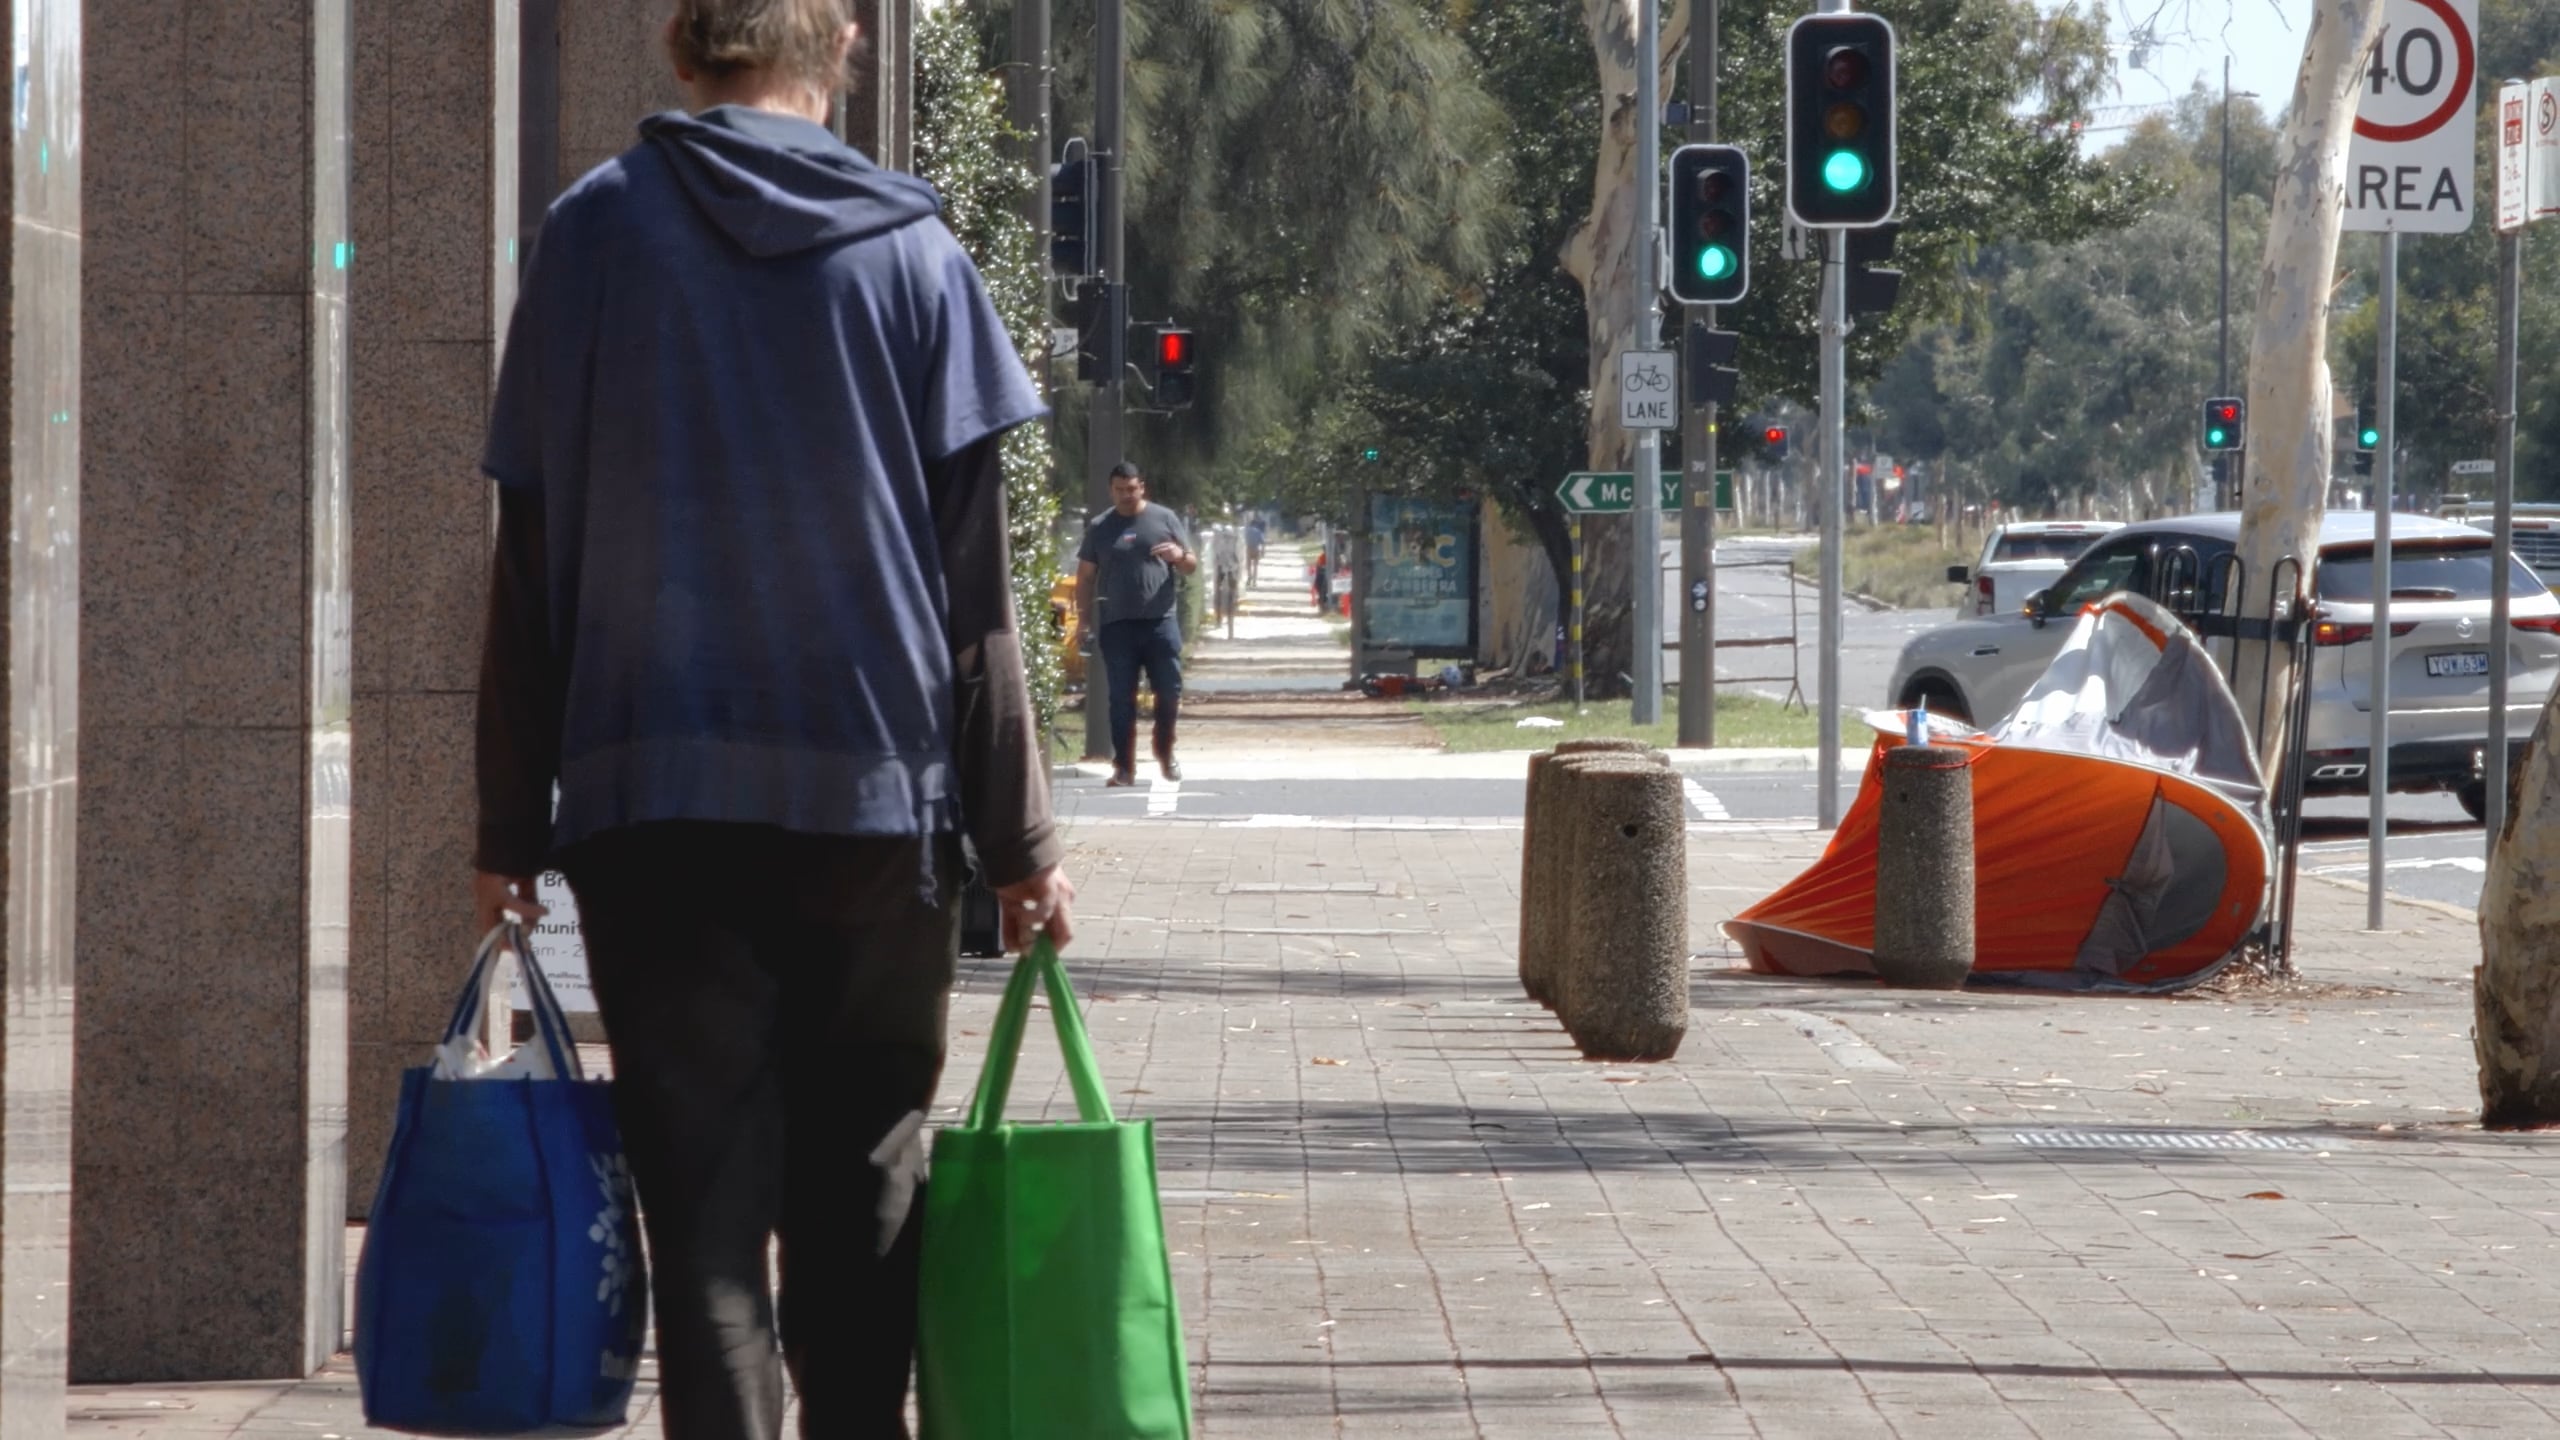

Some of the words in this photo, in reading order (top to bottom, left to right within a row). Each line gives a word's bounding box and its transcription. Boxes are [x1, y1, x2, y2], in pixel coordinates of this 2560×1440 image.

[2366, 28, 2442, 96] 40
[1627, 402, 1668, 419] LANE
[1601, 483, 1679, 502] McY
